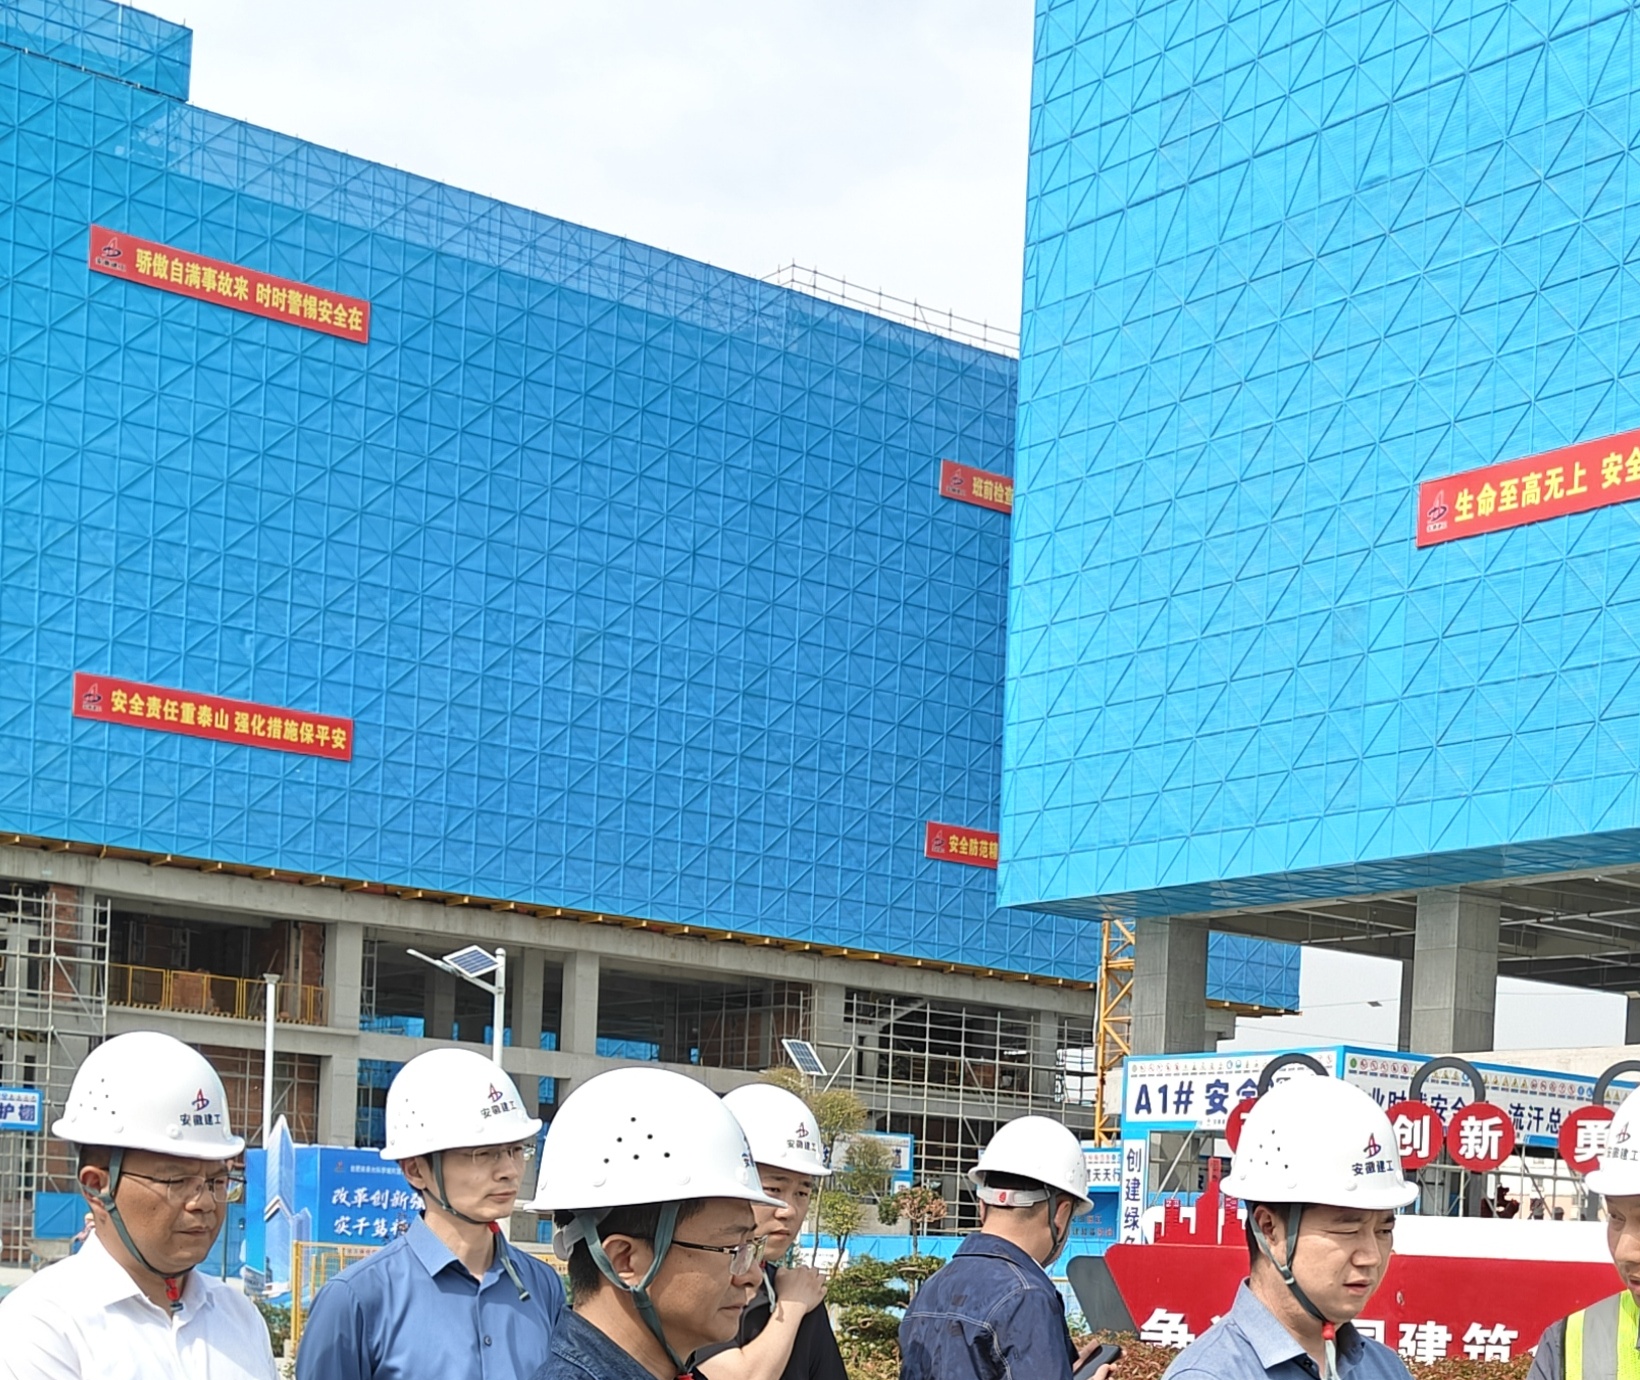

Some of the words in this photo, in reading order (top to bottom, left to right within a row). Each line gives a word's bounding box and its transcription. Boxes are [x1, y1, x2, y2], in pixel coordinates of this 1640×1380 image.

[136, 248, 249, 300] 骄傲自满事故来
[256, 283, 363, 331] 时时警惕安全在
[1454, 462, 1588, 523] 生命至高无上
[111, 689, 229, 730] 安全责任重泰山
[234, 711, 347, 749] 强化措施保平安
[180, 1113, 221, 1127] 安徽建工
[480, 1100, 517, 1119] 安徽建工
[1508, 1103, 1573, 1134] 流汗总
[1351, 1159, 1394, 1176] 安徽建工
